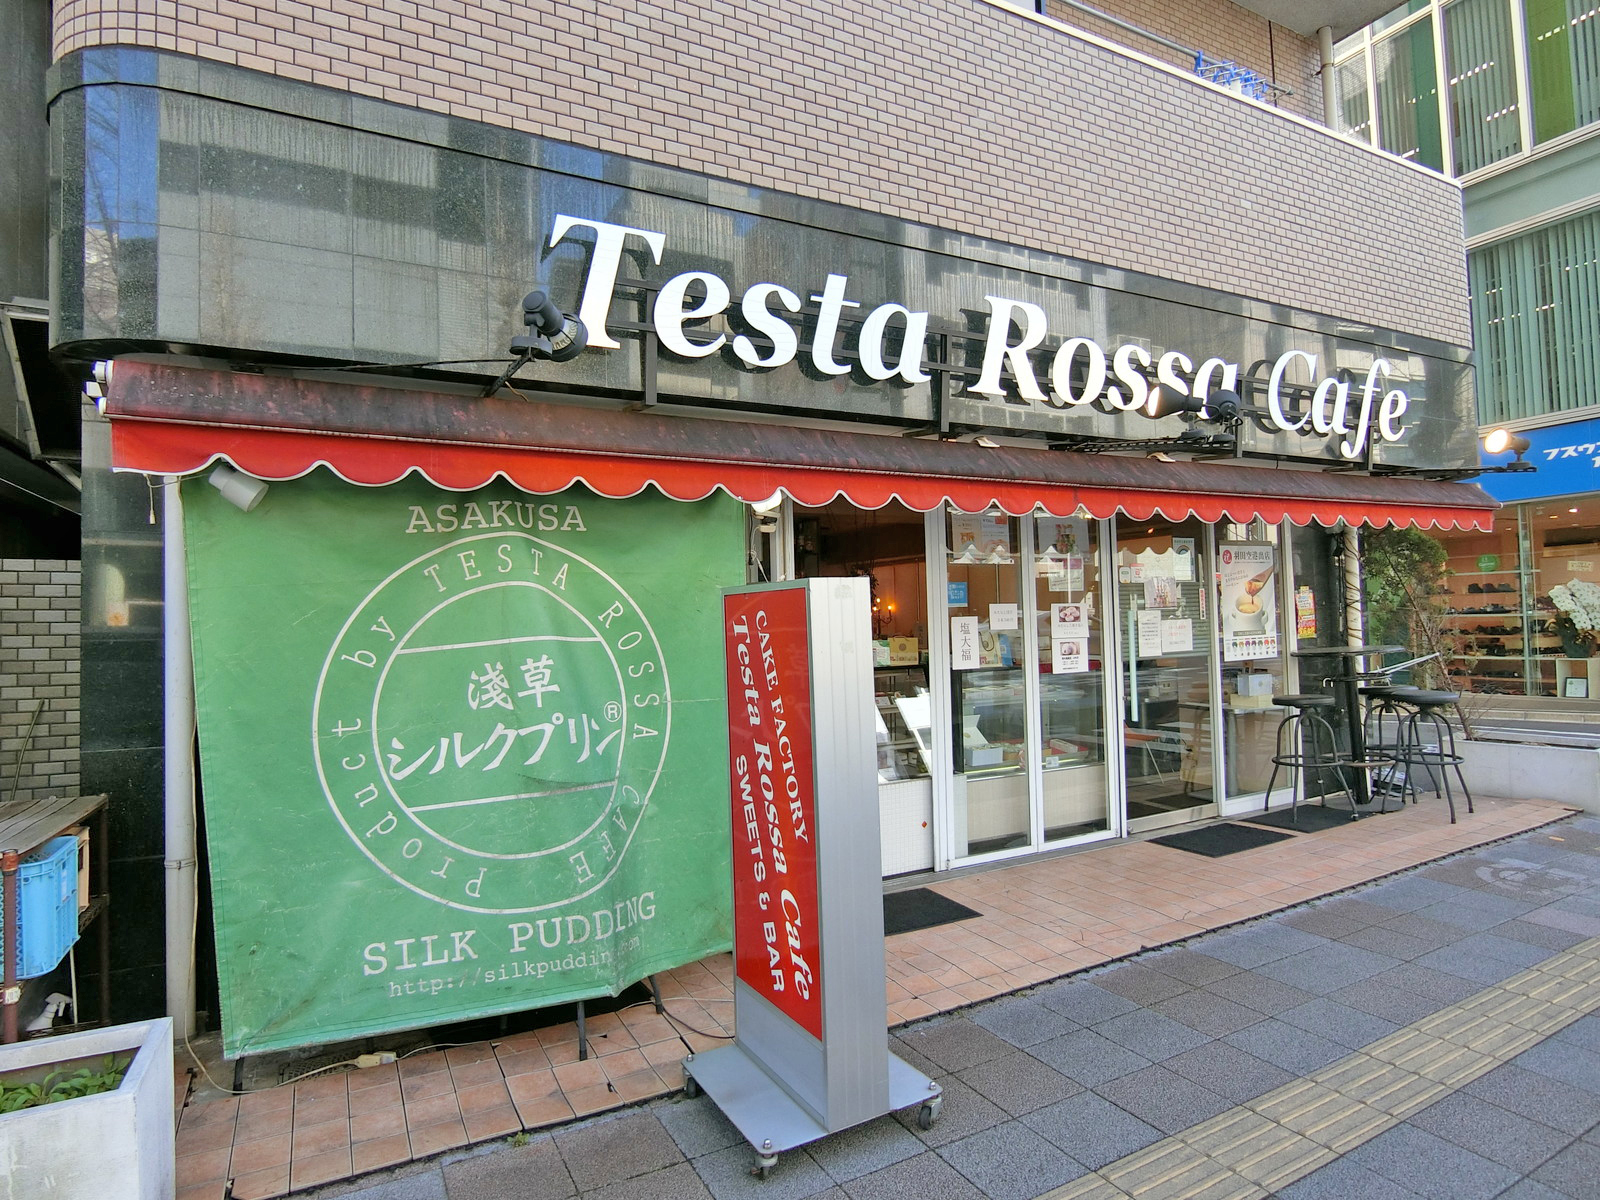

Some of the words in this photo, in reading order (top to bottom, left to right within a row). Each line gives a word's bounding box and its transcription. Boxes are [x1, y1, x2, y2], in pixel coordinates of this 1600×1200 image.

[549, 213, 932, 384] Testa
[967, 295, 1240, 420] Rossa
[1268, 349, 1410, 460] Cafe
[405, 500, 588, 534] ASAKUSA
[423, 544, 570, 593] TESTA
[341, 615, 397, 669] by
[597, 600, 661, 740] ROSSA
[959, 621, 972, 662] 塩大福
[386, 712, 622, 781] シルクプリン
[755, 610, 779, 691] CAKE
[770, 695, 809, 843] FACTORY
[331, 717, 488, 898] product
[568, 784, 641, 885] CAFE
[732, 614, 762, 727] Testa
[753, 738, 788, 874] Rossa
[780, 889, 813, 1001] Cafe
[736, 754, 767, 883] SWEETS
[763, 921, 785, 992] BAR
[362, 930, 479, 976] SILK
[508, 891, 657, 953] PUDDING
